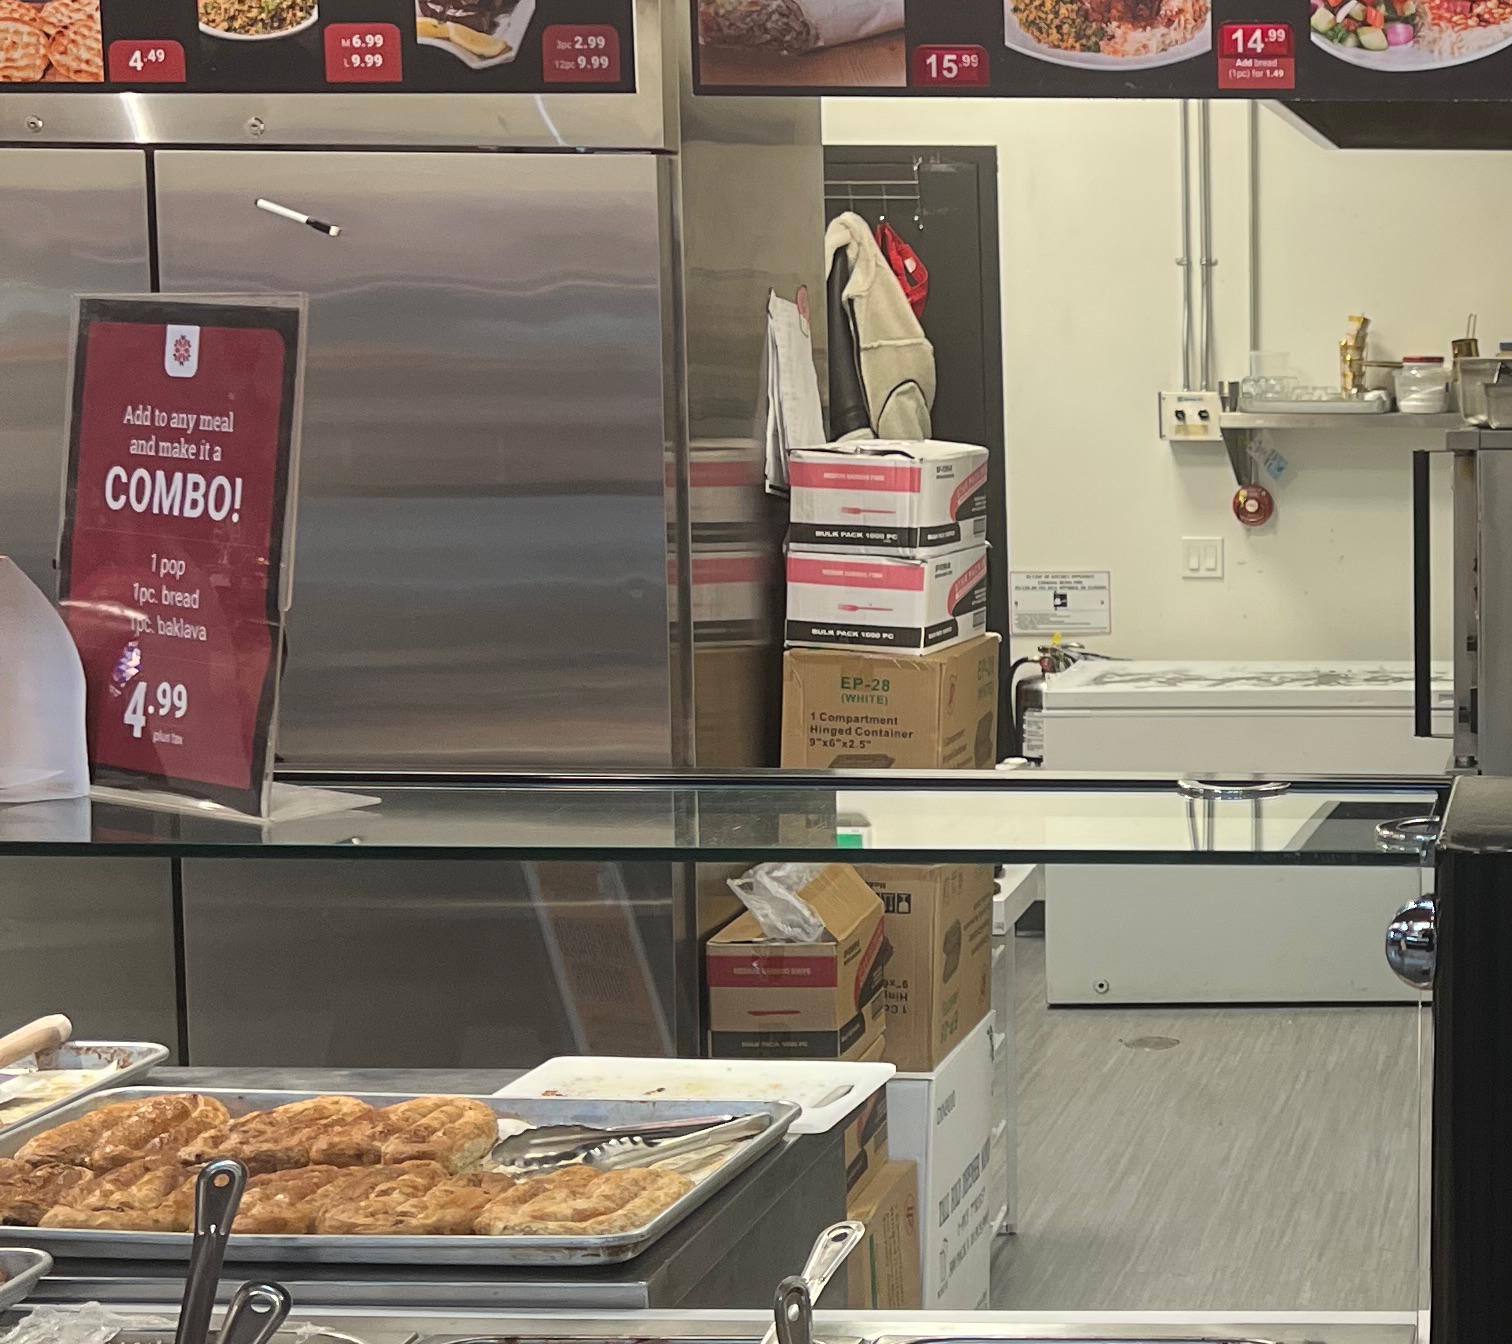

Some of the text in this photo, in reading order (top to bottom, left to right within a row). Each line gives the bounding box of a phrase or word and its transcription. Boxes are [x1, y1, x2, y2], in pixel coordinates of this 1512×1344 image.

[1232, 29, 1285, 53] 14.99
[129, 49, 164, 70] 4.49
[926, 54, 978, 78] 15.99
[123, 405, 234, 434] Add to any meal
[129, 436, 222, 462] and make it a
[104, 465, 243, 523] COMBO!
[150, 553, 186, 581] 1 pop
[132, 582, 200, 609] 1pc. bread
[156, 615, 208, 641] baklava
[840, 675, 890, 693] EP-28
[123, 680, 188, 739] 4.99
[840, 693, 889, 706] (WHITE)
[810, 712, 898, 727] 1 Compartment
[809, 725, 914, 740] Hinged Container
